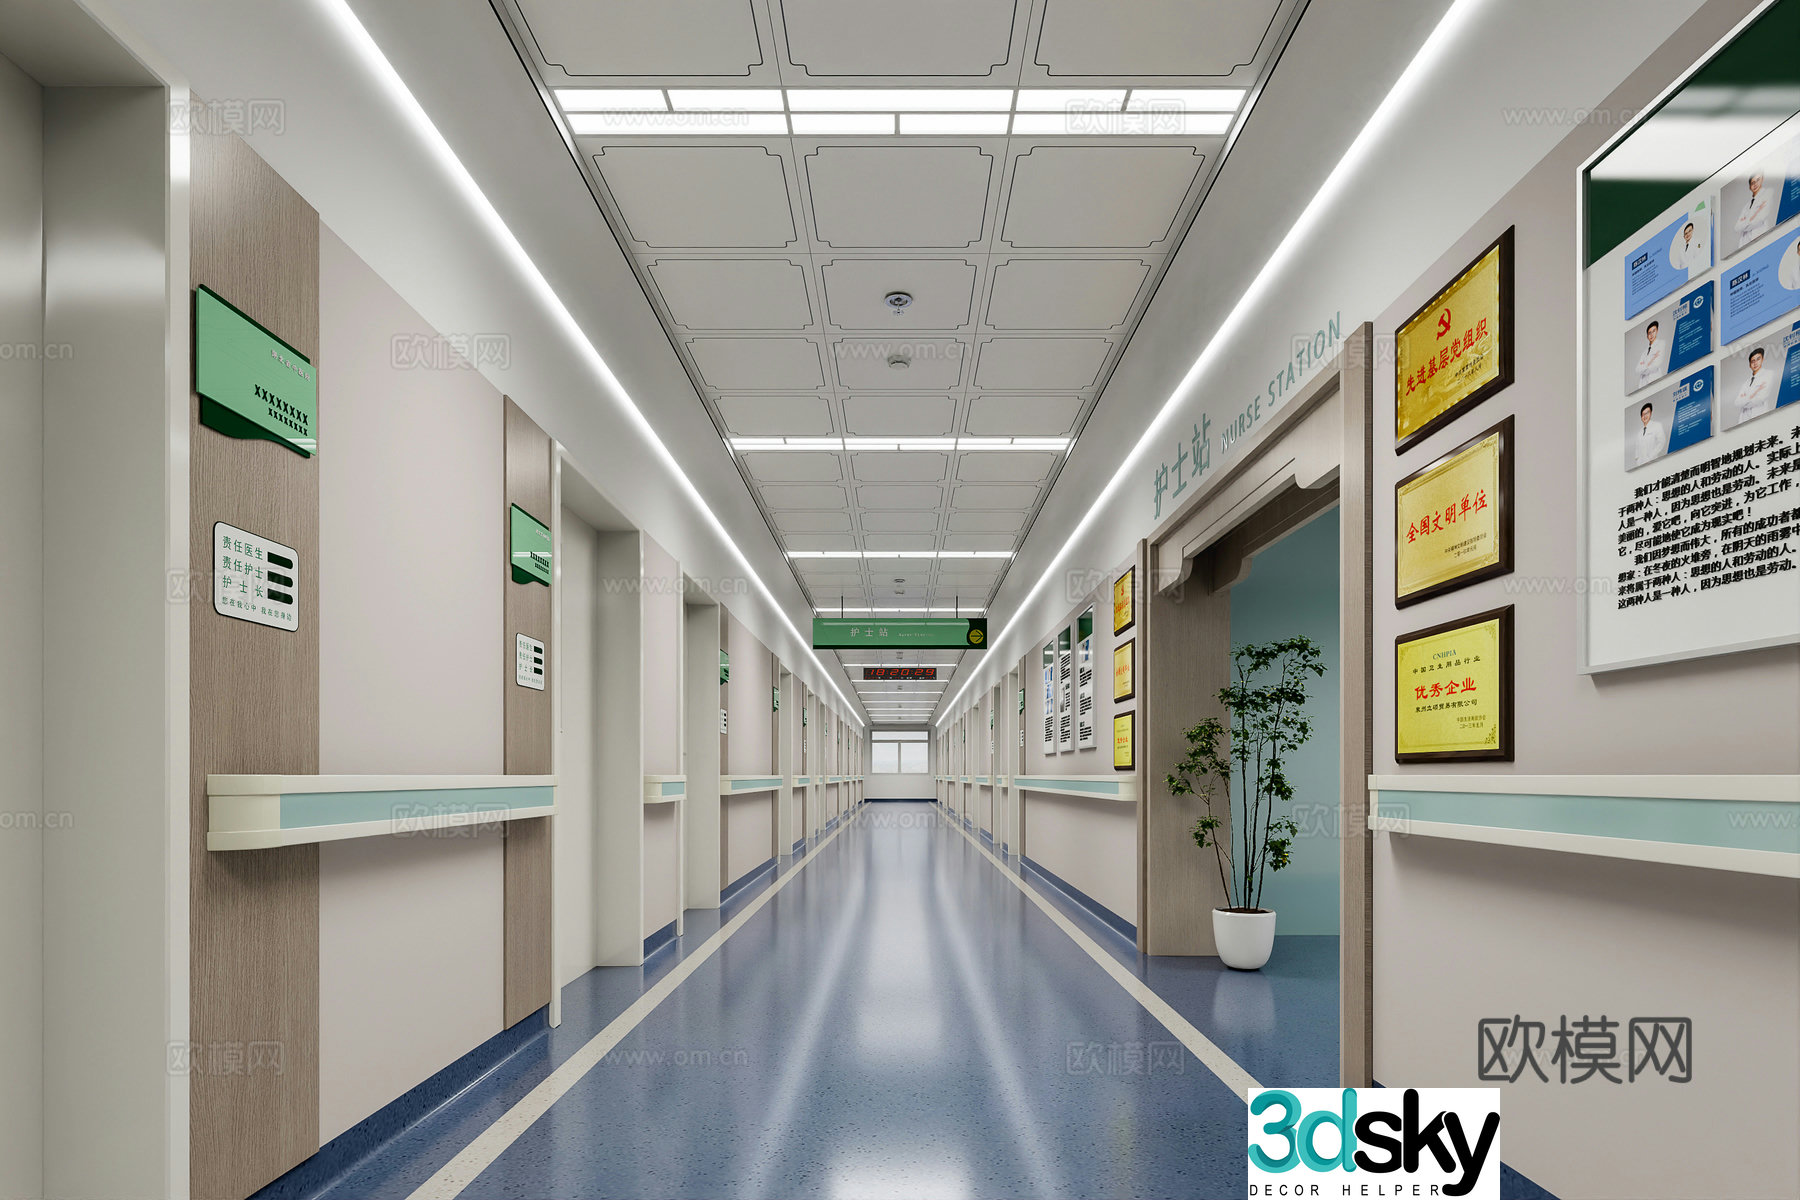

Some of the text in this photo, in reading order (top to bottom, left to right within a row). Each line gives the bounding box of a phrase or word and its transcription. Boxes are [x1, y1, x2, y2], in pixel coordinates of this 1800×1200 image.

[1405, 316, 1489, 397] 先进基层党组织
[1153, 311, 1341, 520] 护士站 NURSE STATION
[1405, 489, 1487, 544] 全国文明单位
[222, 535, 263, 561] 责任医生
[222, 555, 264, 580] 责任护士
[850, 627, 888, 637] 护士站
[870, 668, 935, 676] 18:20:29
[1412, 655, 1481, 674] 中国卫生用品行业
[1414, 676, 1477, 701] 优秀企业
